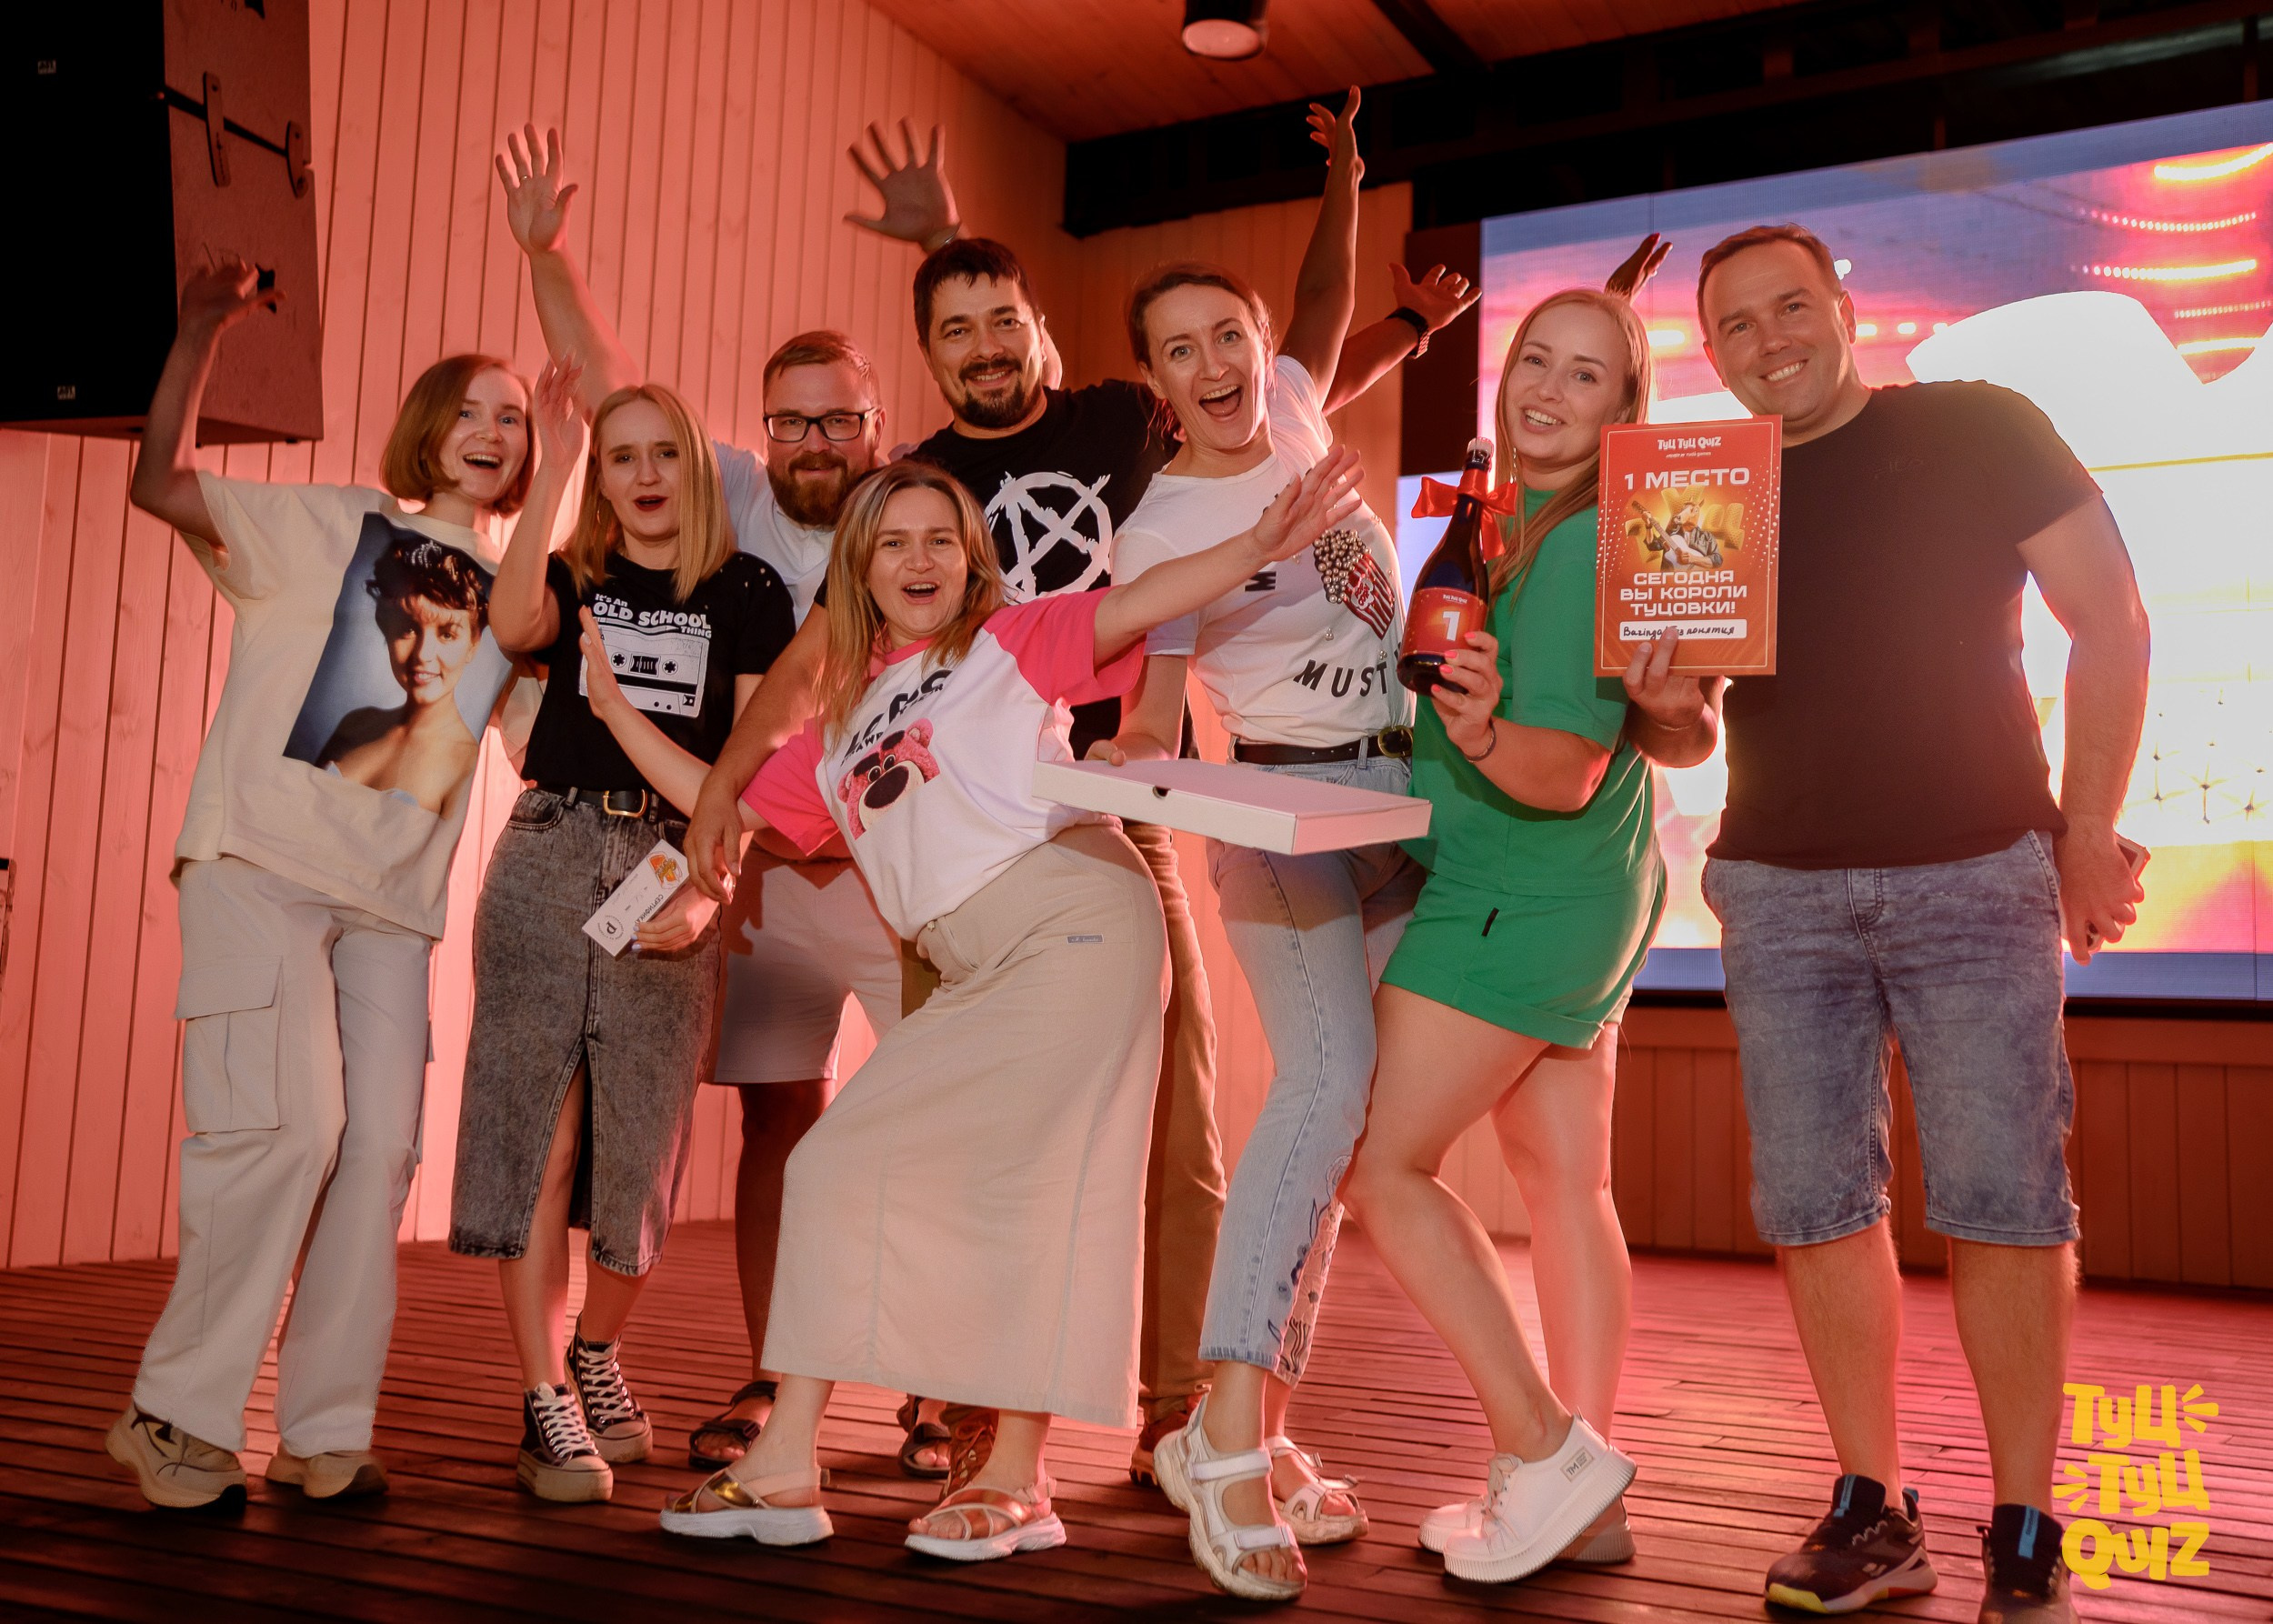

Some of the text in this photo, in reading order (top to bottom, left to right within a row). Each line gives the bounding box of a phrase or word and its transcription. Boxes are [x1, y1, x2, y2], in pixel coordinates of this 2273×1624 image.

[1624, 467, 1750, 490] 1 МЕСТО
[1633, 570, 1735, 585] СЕГОДНЯ
[1620, 586, 1747, 601] ВЫ КОРОЛИ
[613, 598, 628, 607] An
[1630, 601, 1736, 617] ТУЦОВКИ!
[593, 602, 712, 630] OLD SCHOOL
[680, 626, 712, 638] THING
[1443, 611, 1461, 641] 1
[1293, 659, 1388, 698] MUST
